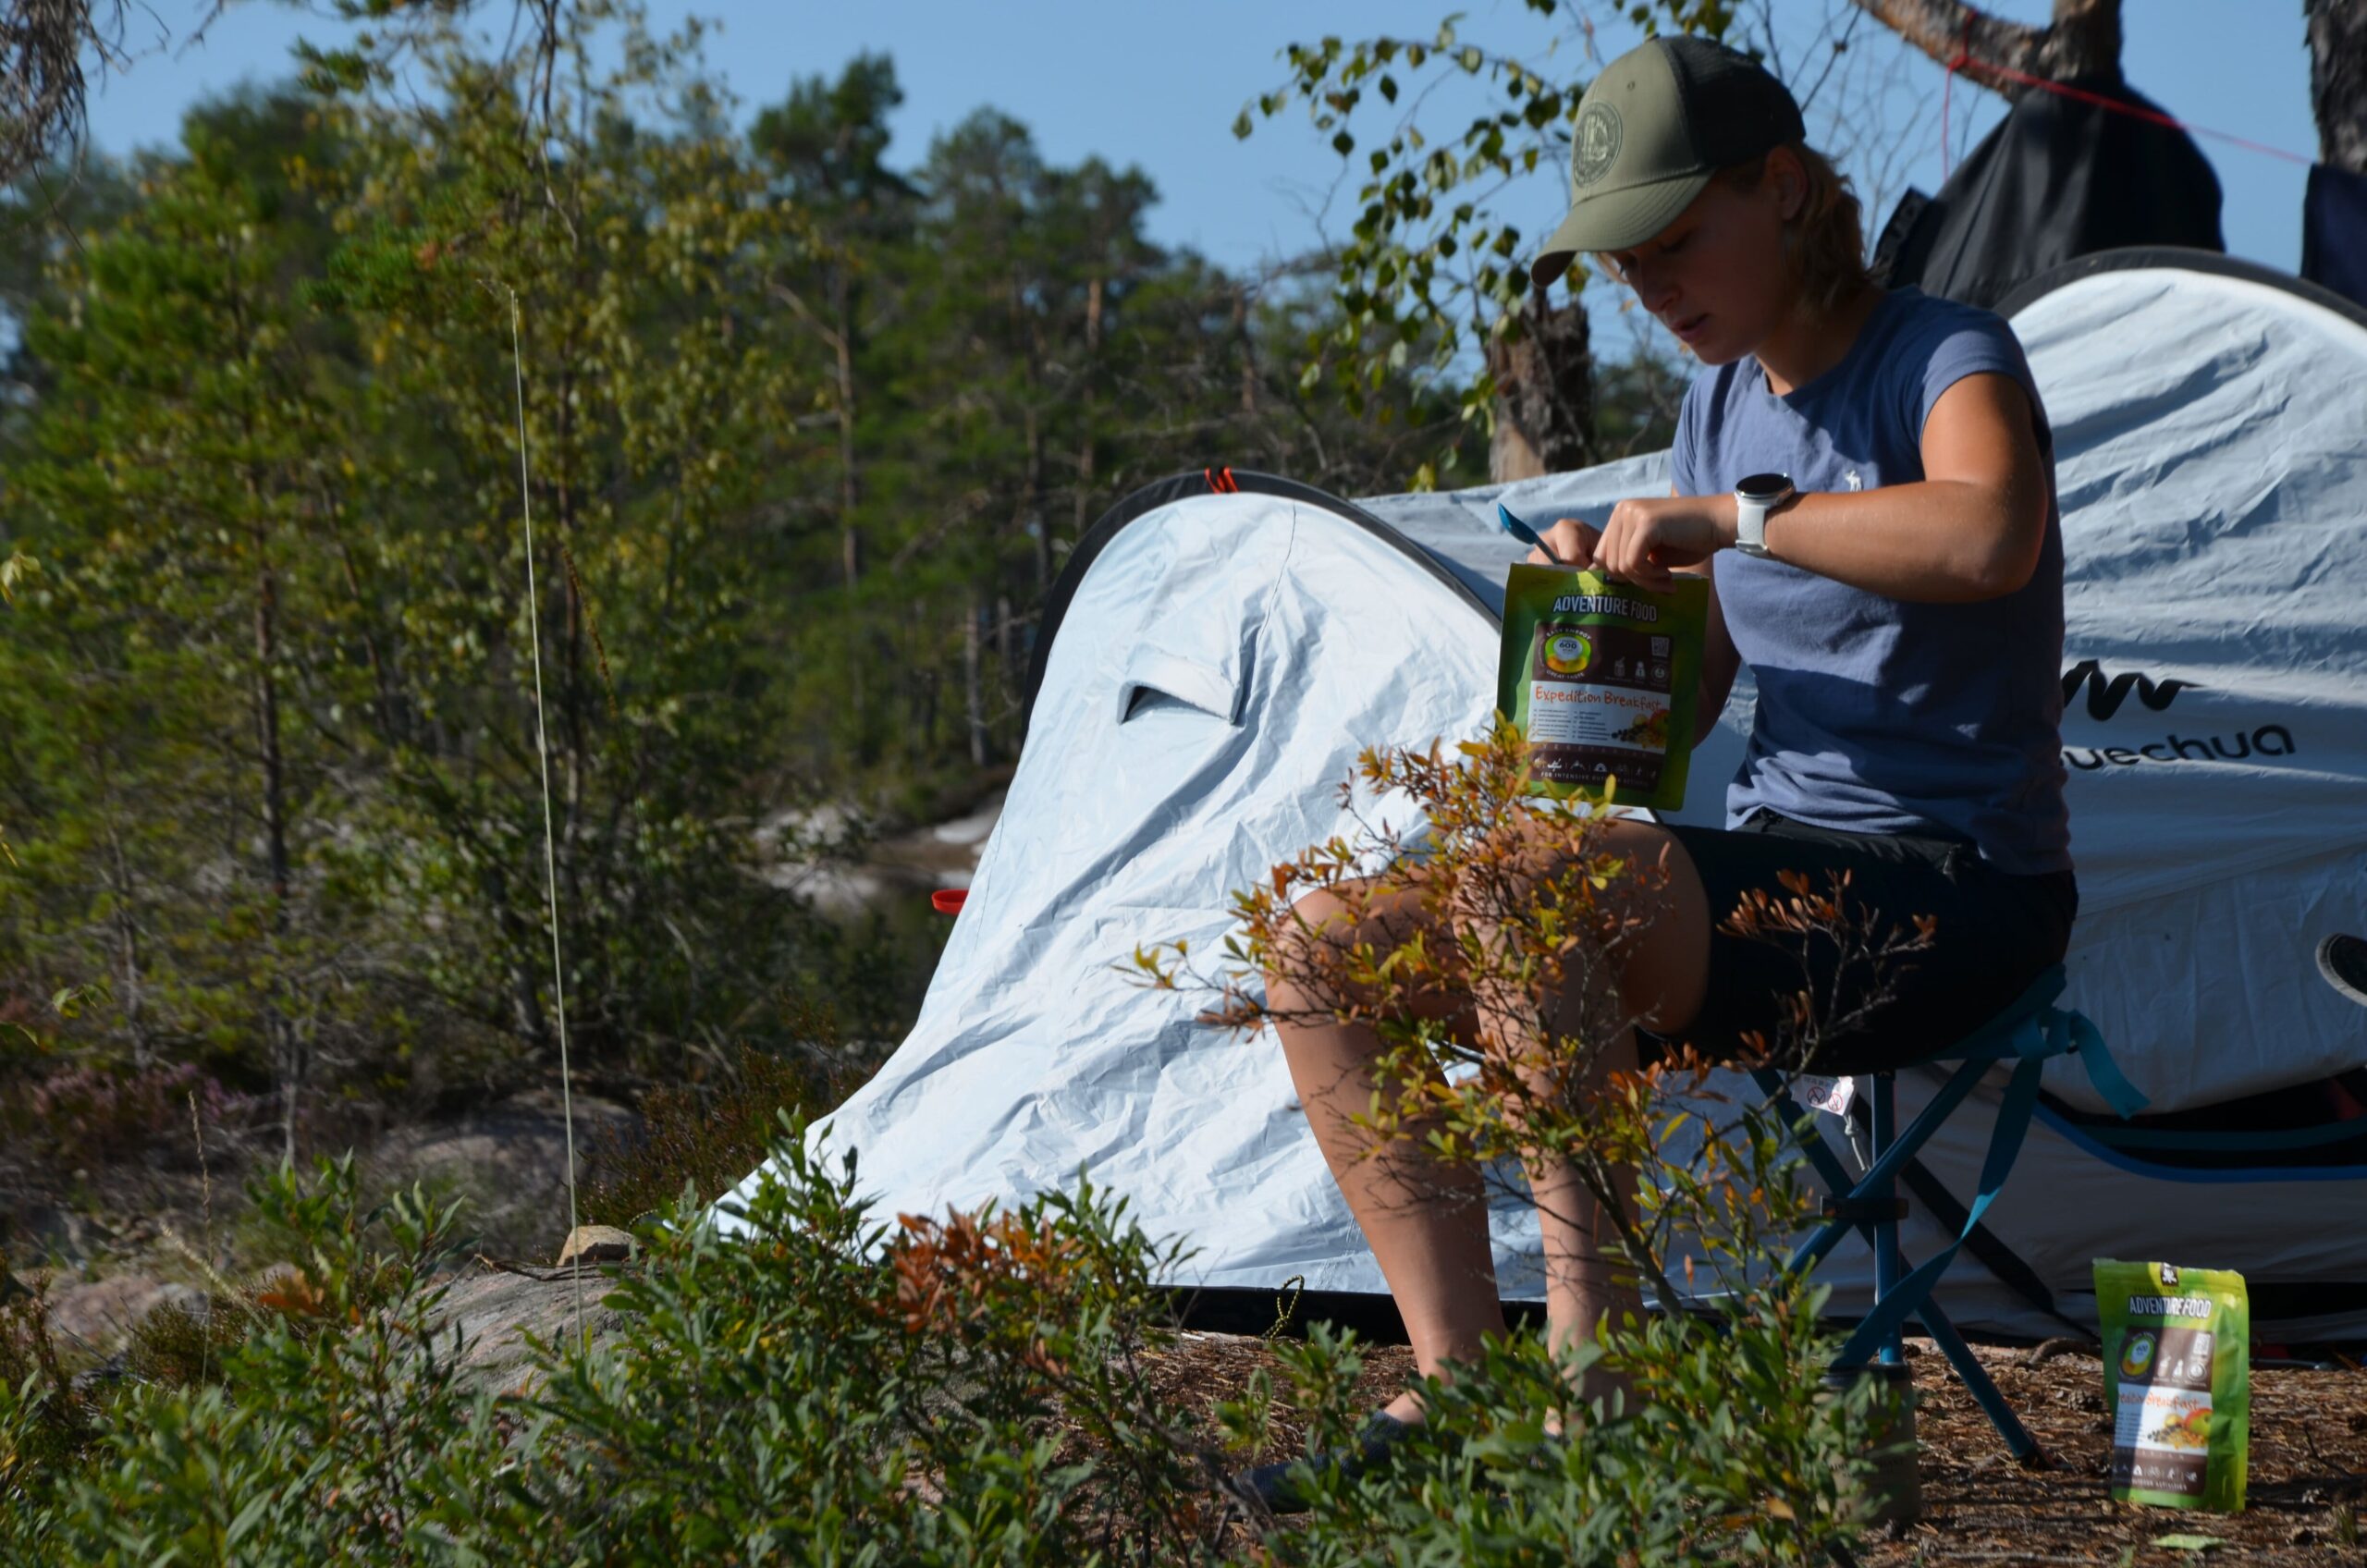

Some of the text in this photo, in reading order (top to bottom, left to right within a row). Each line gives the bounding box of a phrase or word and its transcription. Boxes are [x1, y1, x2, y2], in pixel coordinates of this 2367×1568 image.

[1552, 595, 1658, 622] ADVENTURE FOOD
[1559, 642, 1577, 650] 600
[1535, 686, 1663, 712] Expedition Breakfast
[2057, 725, 2297, 770] uechua
[2129, 1296, 2212, 1318] ADVENTURE FOOD
